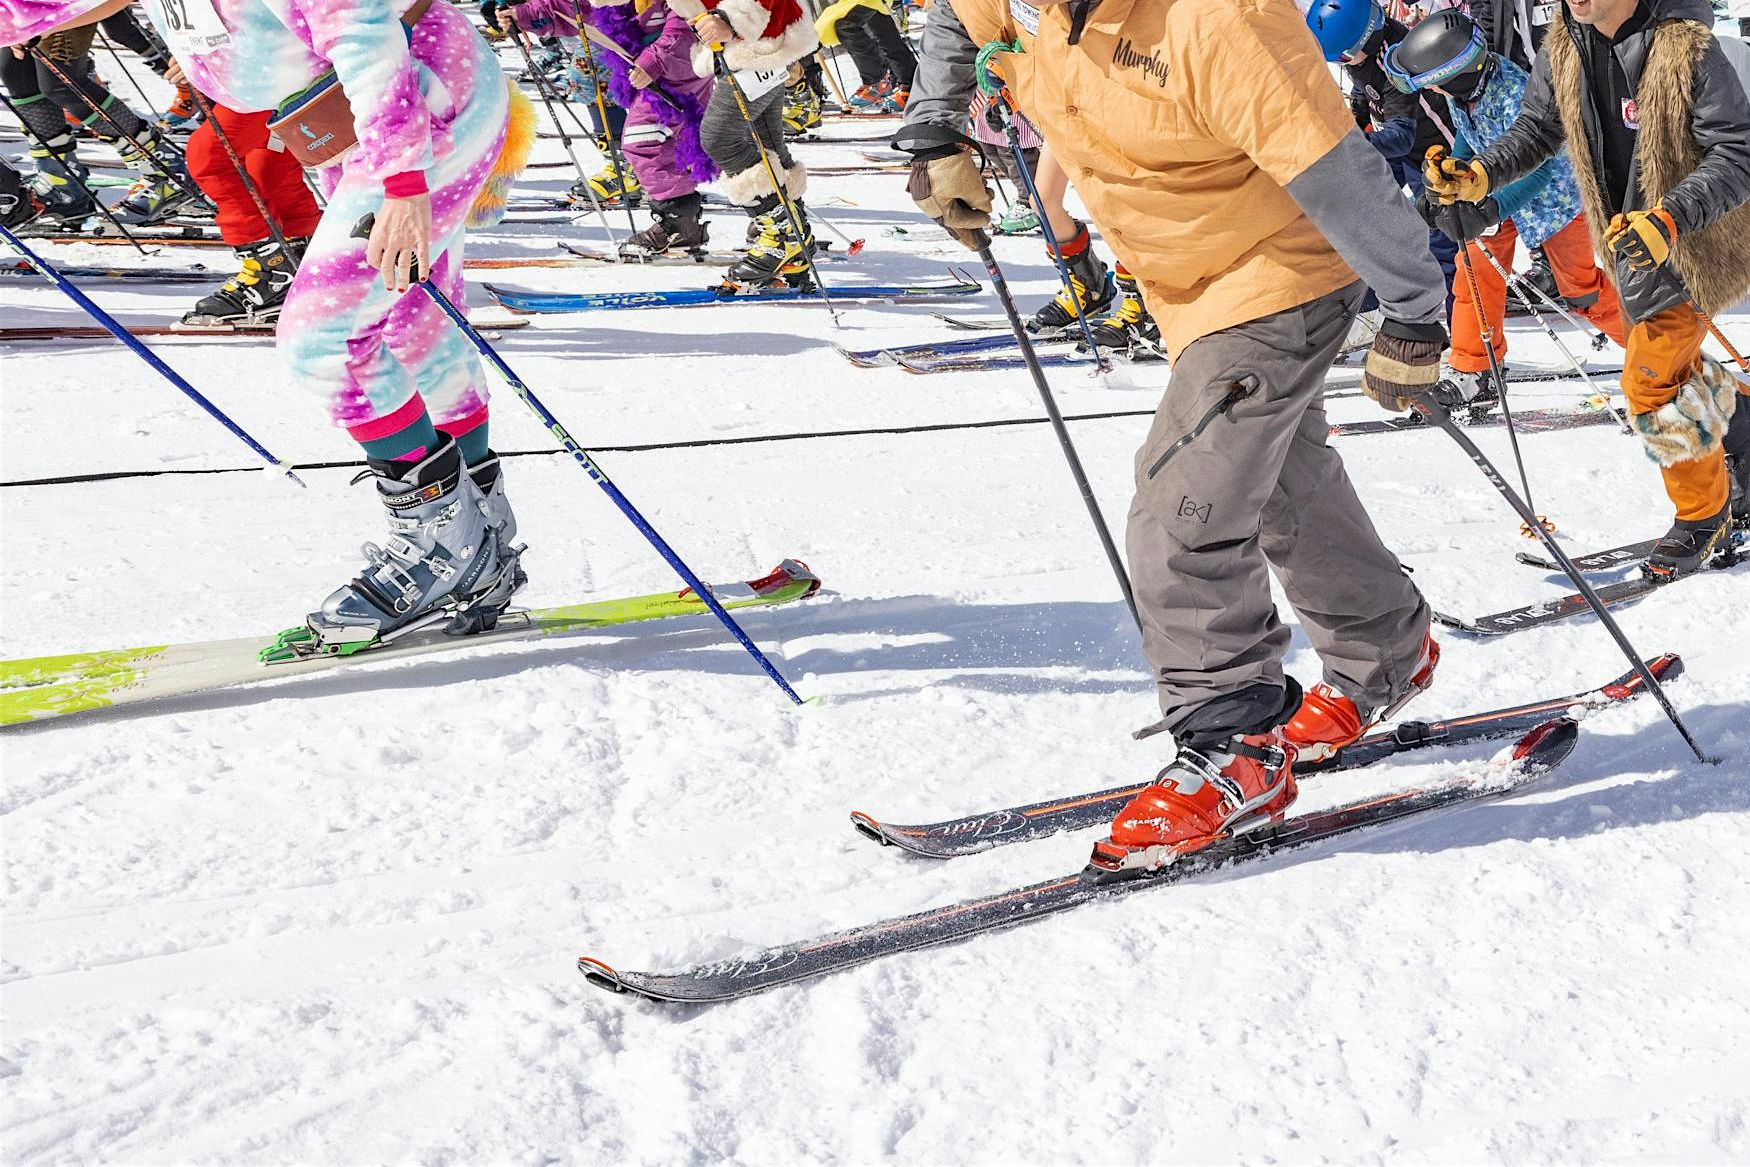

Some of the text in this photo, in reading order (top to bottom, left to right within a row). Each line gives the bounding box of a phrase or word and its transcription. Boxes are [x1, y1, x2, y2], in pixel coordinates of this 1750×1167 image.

[1359, 19, 1376, 46] SMITH
[1112, 37, 1171, 88] Murphy
[550, 423, 609, 486] SCOTT
